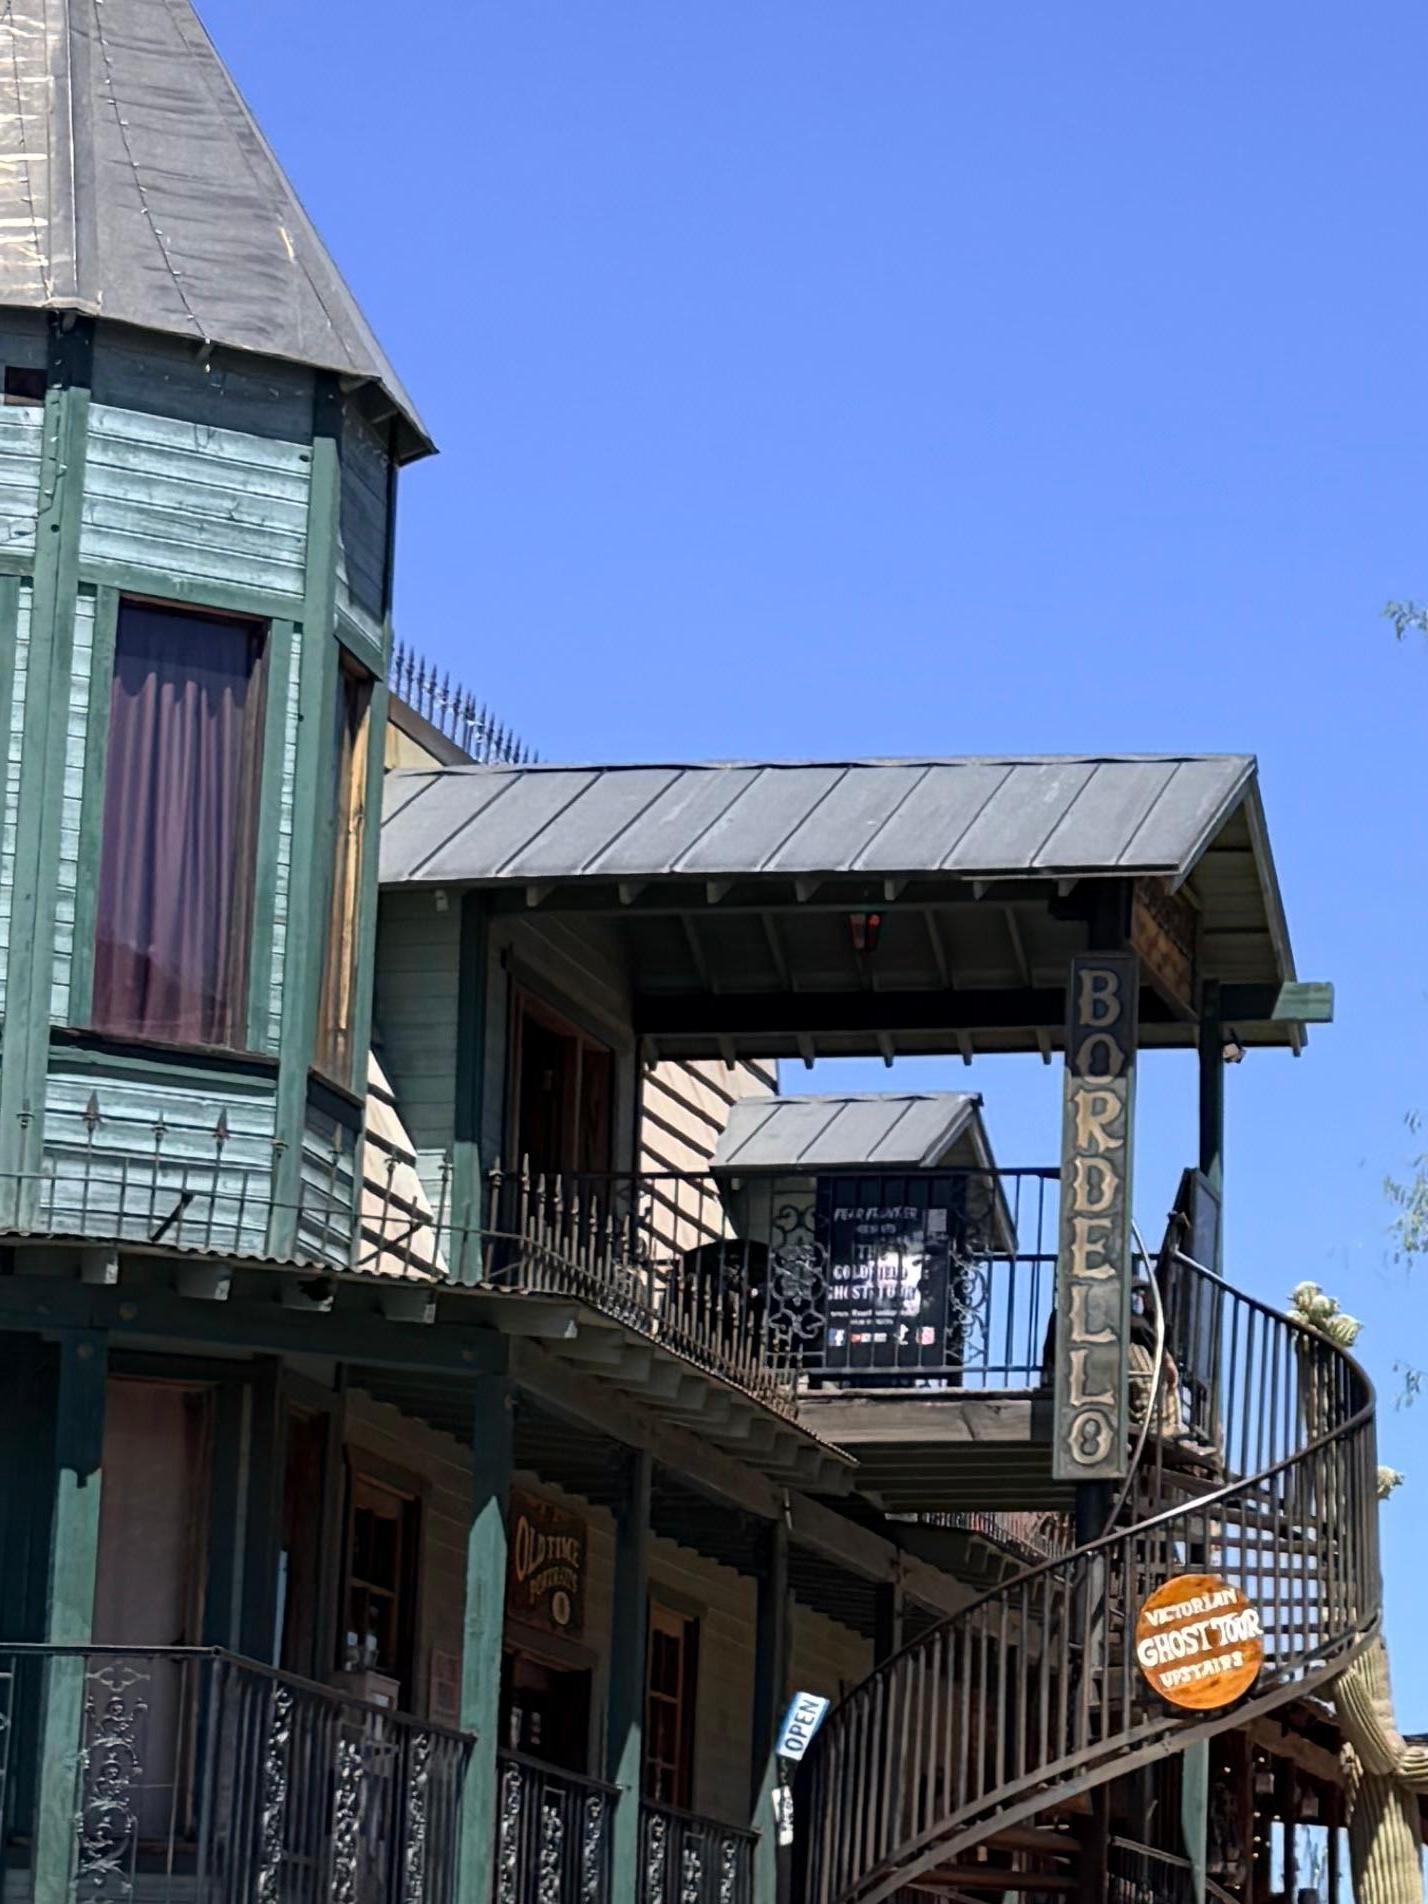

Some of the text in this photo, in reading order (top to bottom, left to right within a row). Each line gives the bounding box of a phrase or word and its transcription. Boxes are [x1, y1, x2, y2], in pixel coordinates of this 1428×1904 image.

[1067, 968, 1124, 1465] BORDELLO
[1144, 1587, 1238, 1627] VICTORIAN
[1136, 1608, 1264, 1667] GHOST TOUR
[1159, 1650, 1244, 1688] UPSTAIRS
[784, 1699, 820, 1752] OPEN
